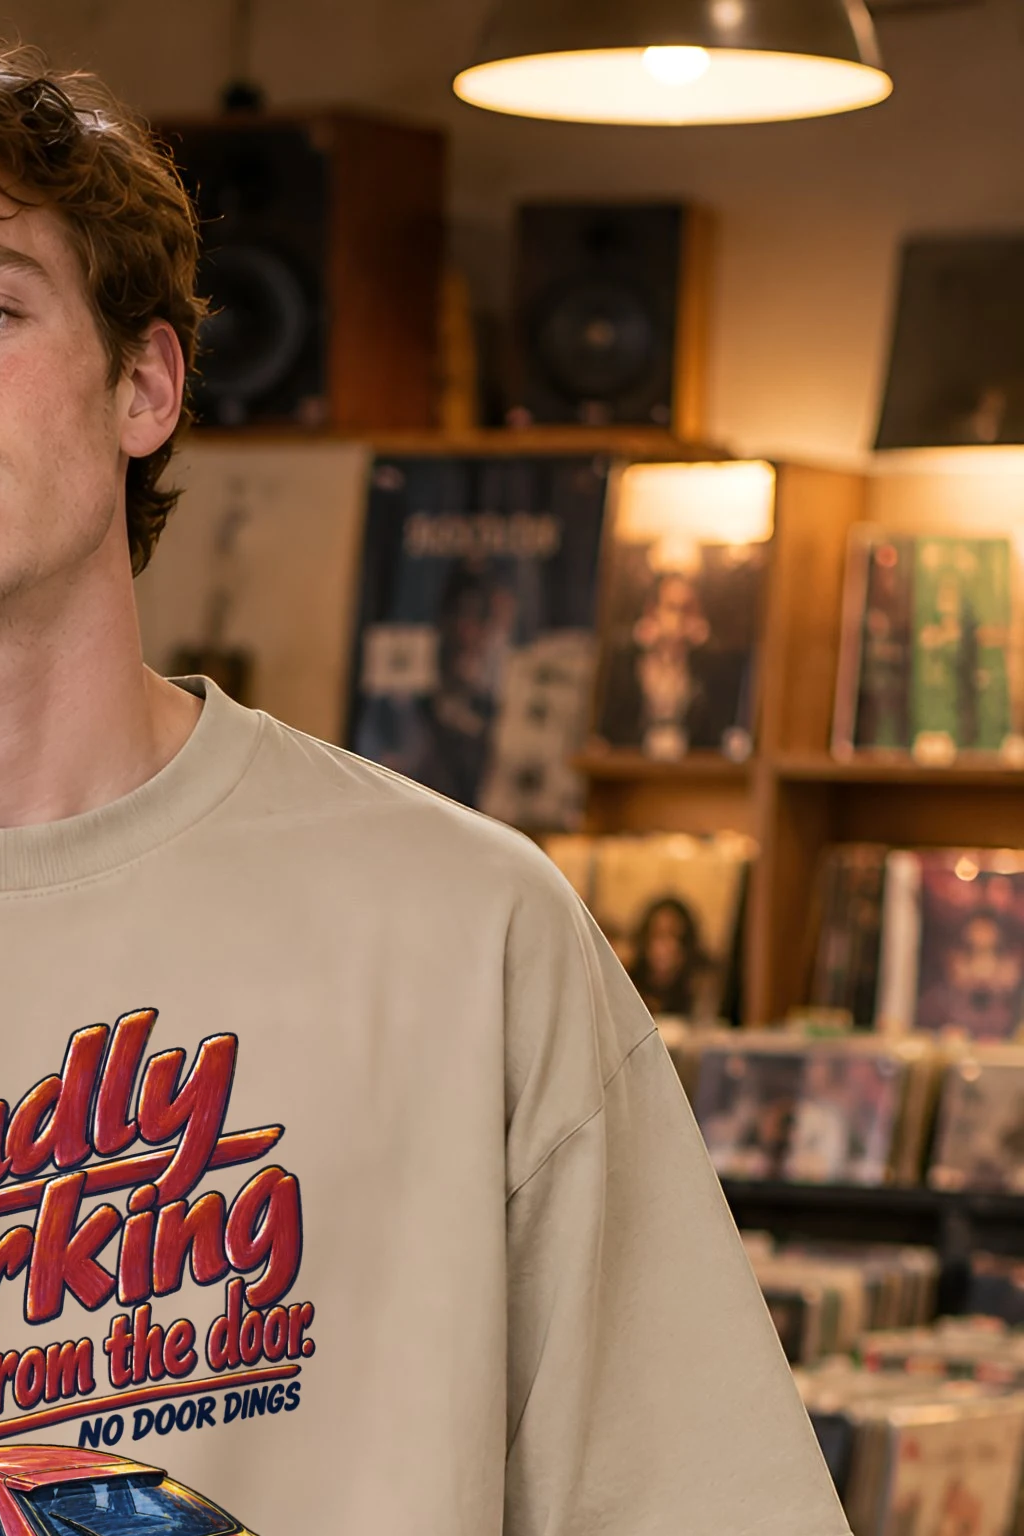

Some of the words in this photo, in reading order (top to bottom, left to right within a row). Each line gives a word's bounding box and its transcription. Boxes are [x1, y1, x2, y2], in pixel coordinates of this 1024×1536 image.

[104, 1303, 197, 1387] the
[207, 1277, 315, 1372] door.
[78, 1414, 124, 1449] NO
[132, 1395, 217, 1442] DOOR
[223, 1381, 301, 1424] DINGS
